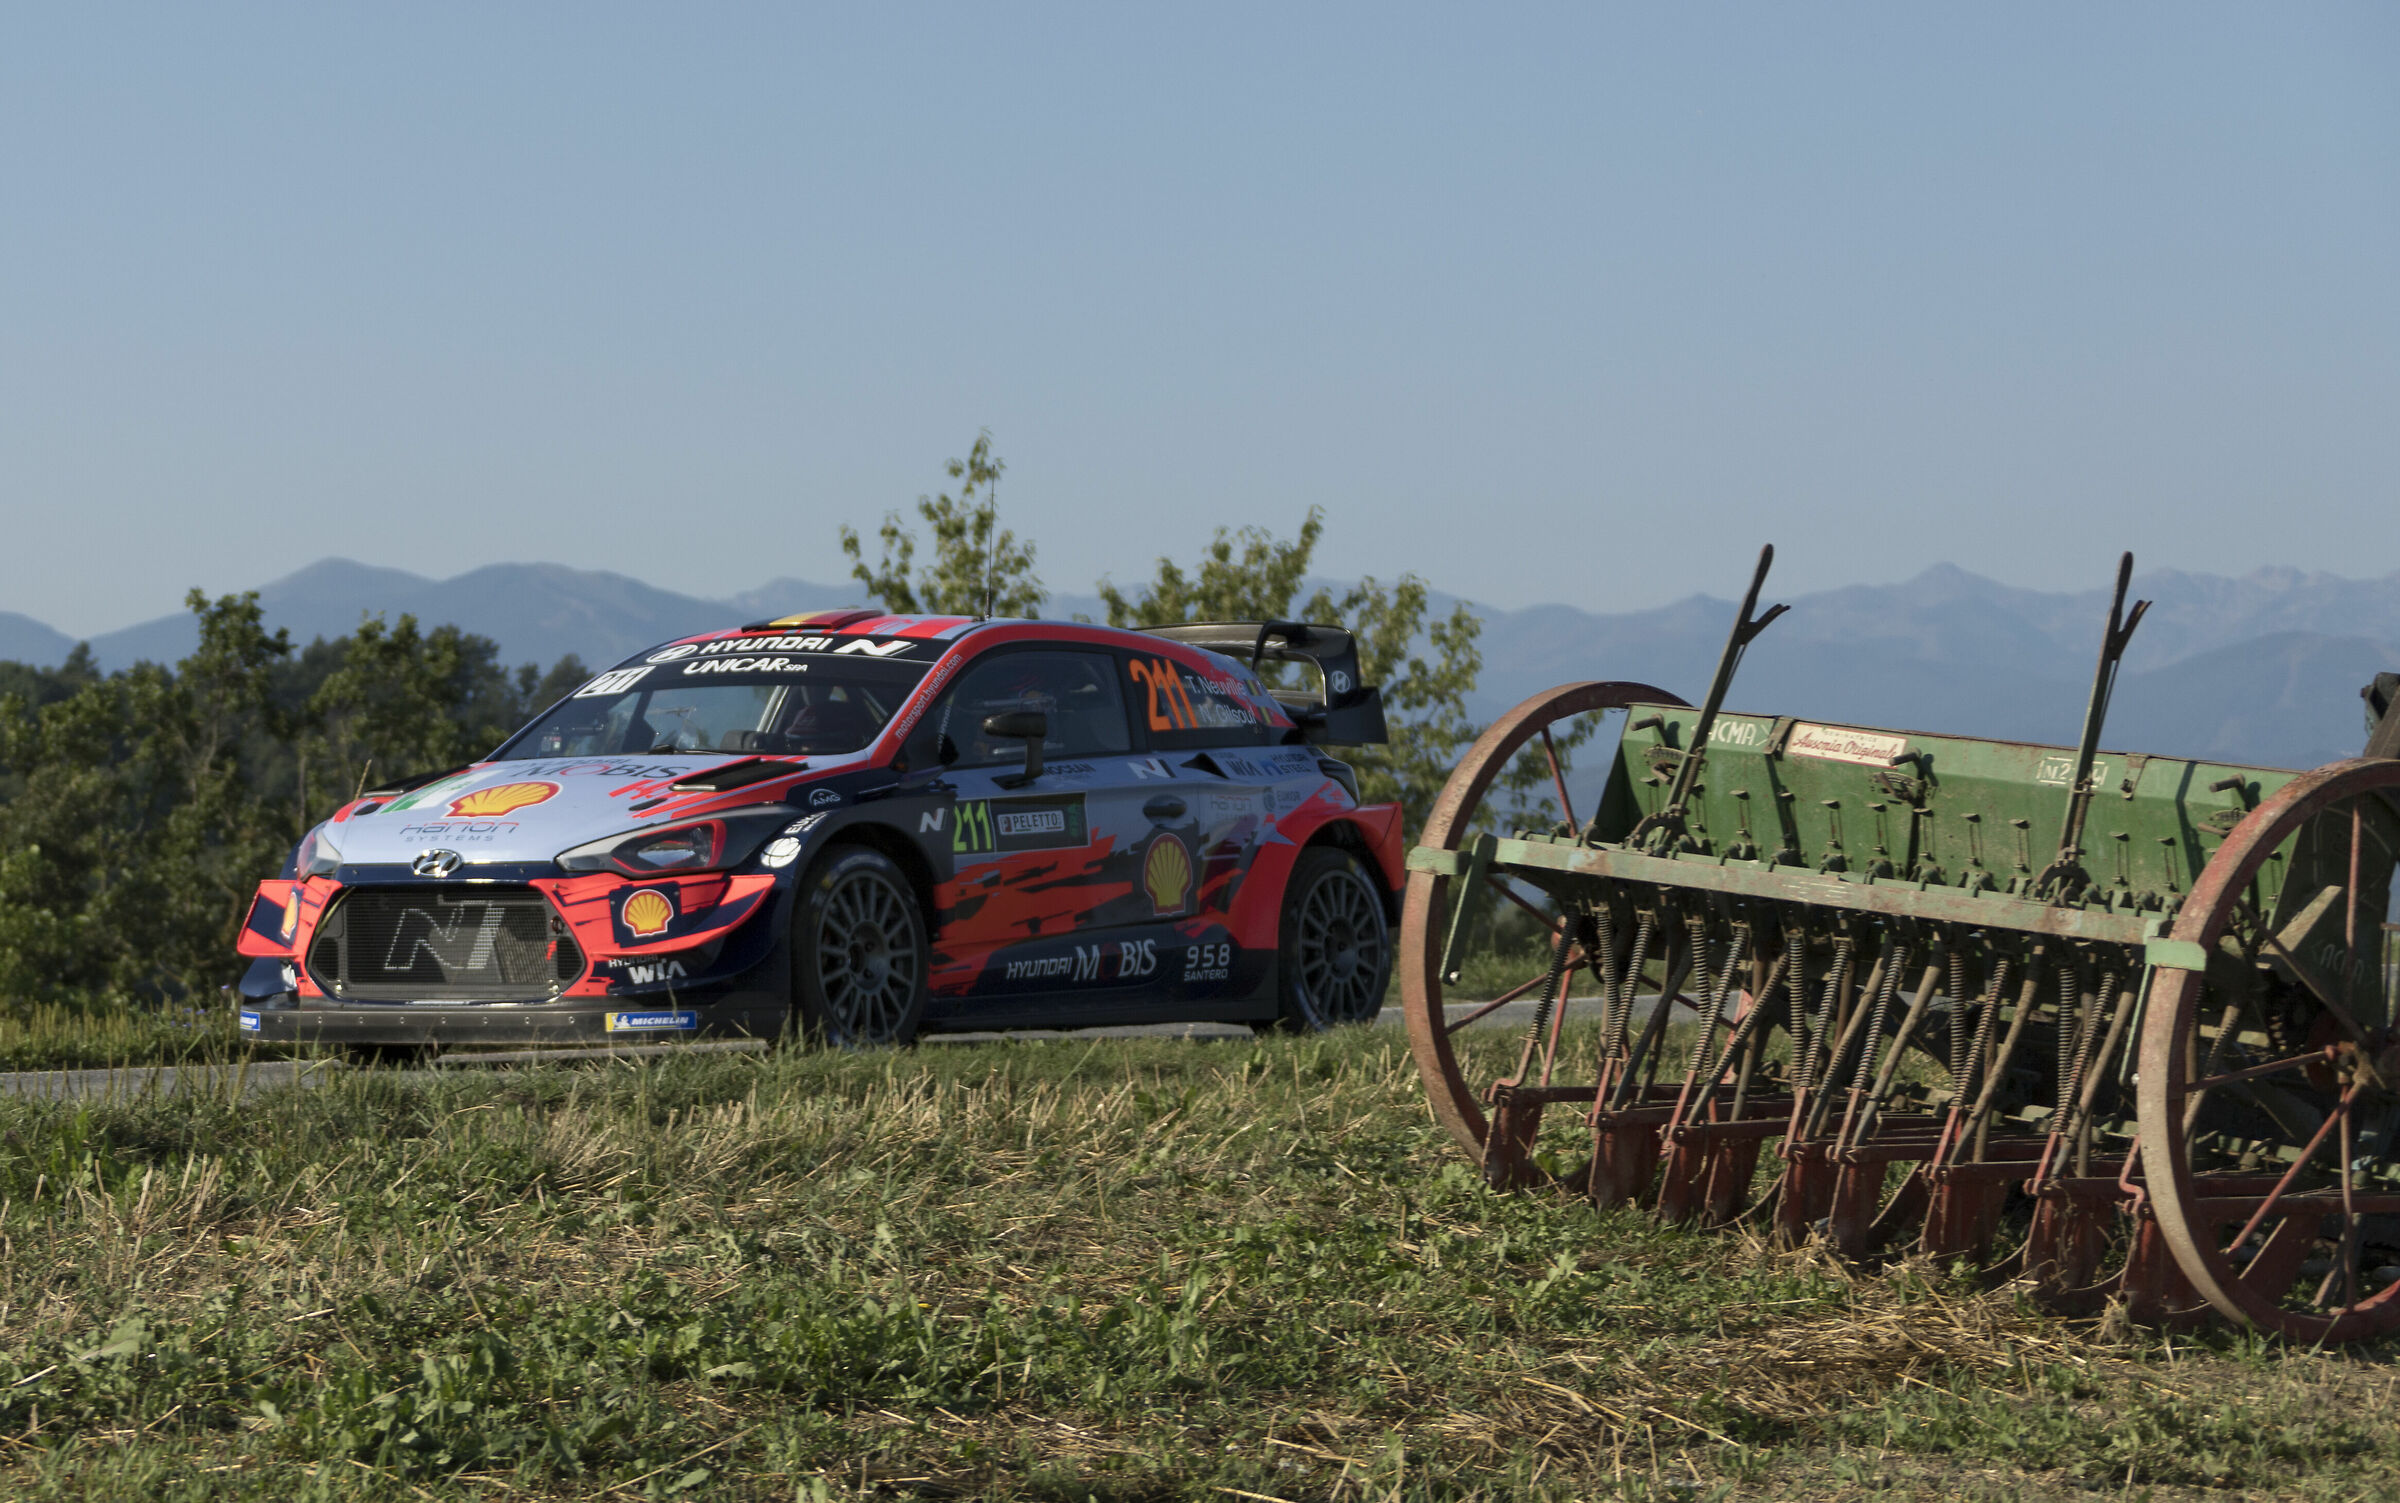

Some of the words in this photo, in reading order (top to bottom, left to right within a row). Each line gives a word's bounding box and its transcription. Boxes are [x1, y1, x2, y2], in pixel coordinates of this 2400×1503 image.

[700, 637, 833, 654] HYUNDAI
[683, 657, 790, 675] UNICAR
[575, 666, 656, 698] 211
[1185, 675, 1201, 694] T.
[1198, 676, 1247, 696] Neuville
[895, 654, 962, 739] motorsport.hyundai.com
[1129, 659, 1198, 731] 211
[1792, 732, 1842, 753] Ausonia
[511, 764, 691, 778] MOBIS
[953, 802, 992, 852] 211
[1013, 812, 1058, 829] PELETTO
[1006, 956, 1073, 979] HYUNDAI
[1073, 938, 1157, 982] MOBIS
[1186, 943, 1230, 969] 958
[628, 958, 688, 984] WIA
[1184, 968, 1228, 982] SANTERO
[631, 1016, 690, 1026] MICHELIN
